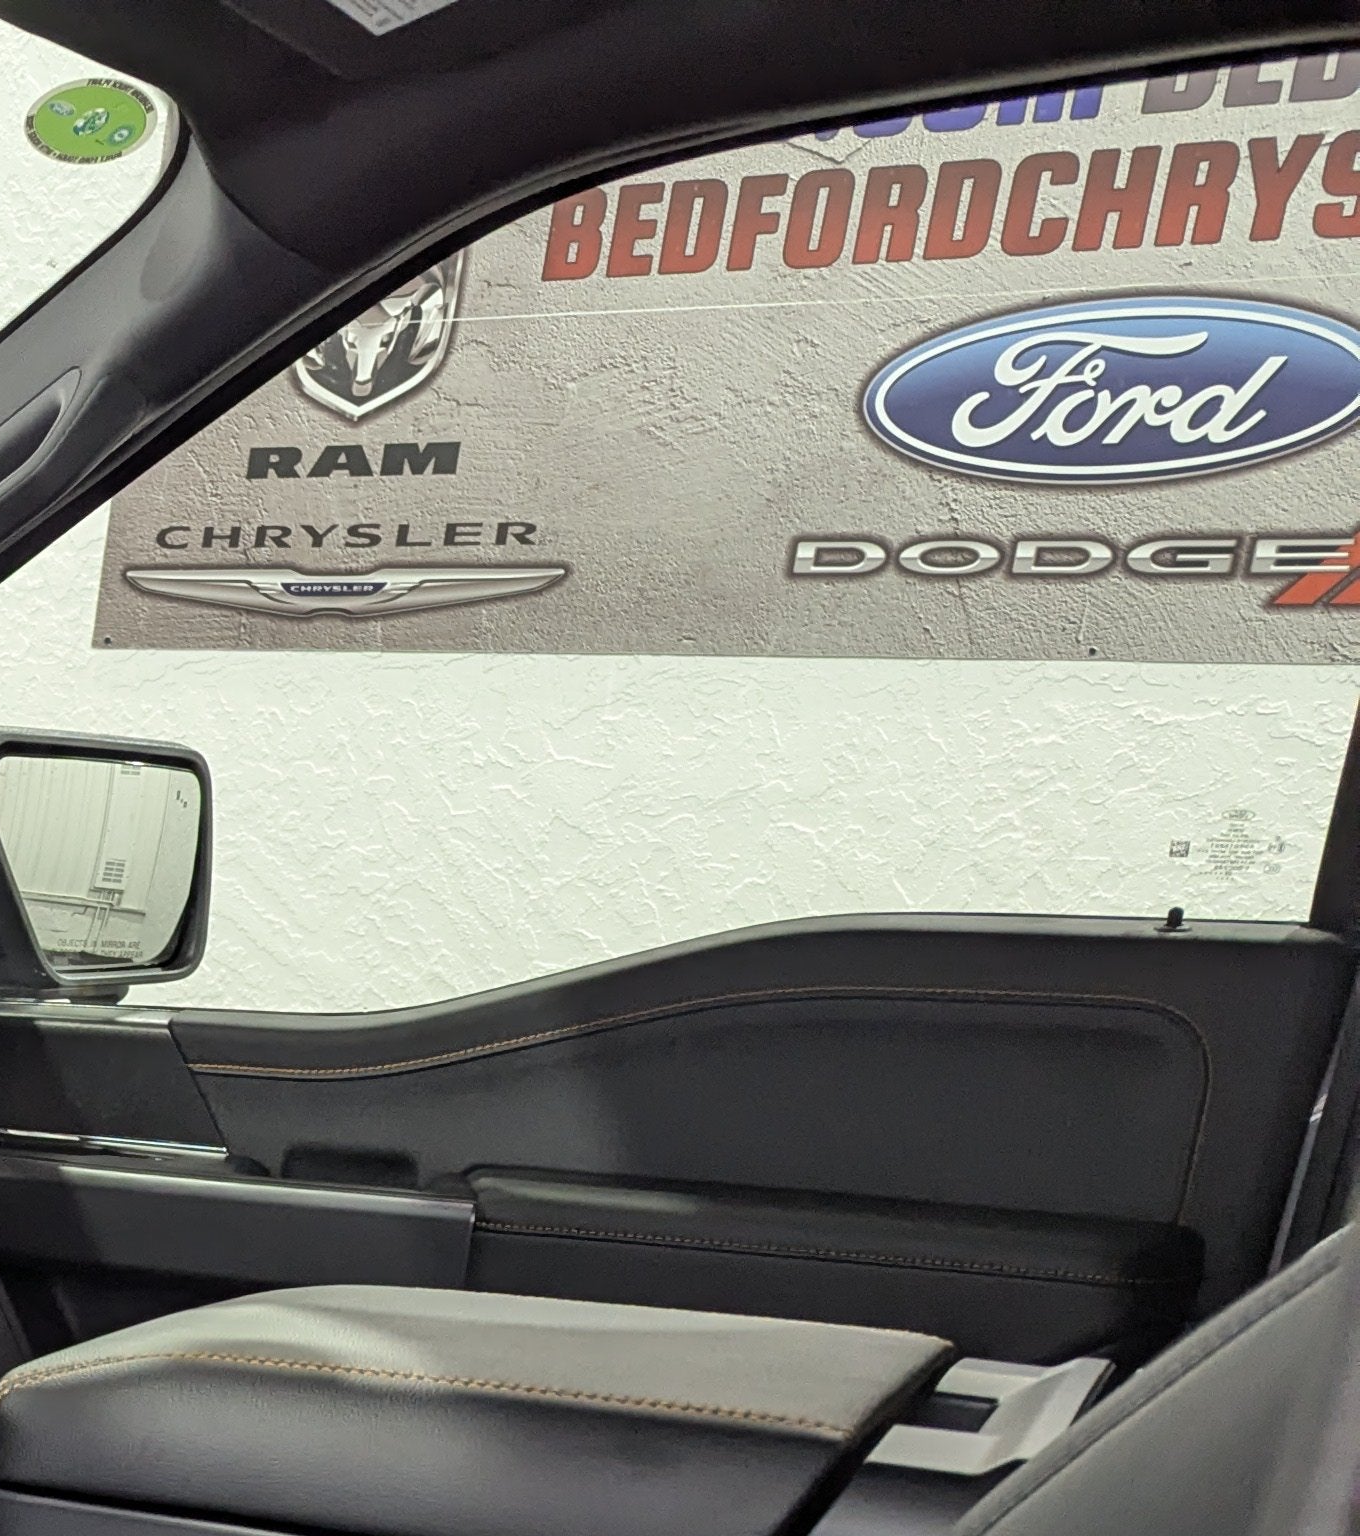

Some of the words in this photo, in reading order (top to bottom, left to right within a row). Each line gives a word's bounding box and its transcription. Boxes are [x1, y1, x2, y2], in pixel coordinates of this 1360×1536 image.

[951, 330, 1288, 448] Ford
[246, 441, 461, 479] RAM
[156, 521, 538, 550] CHRYSLER
[791, 538, 1356, 575] DODGE
[290, 584, 374, 594] CHRYSLER
